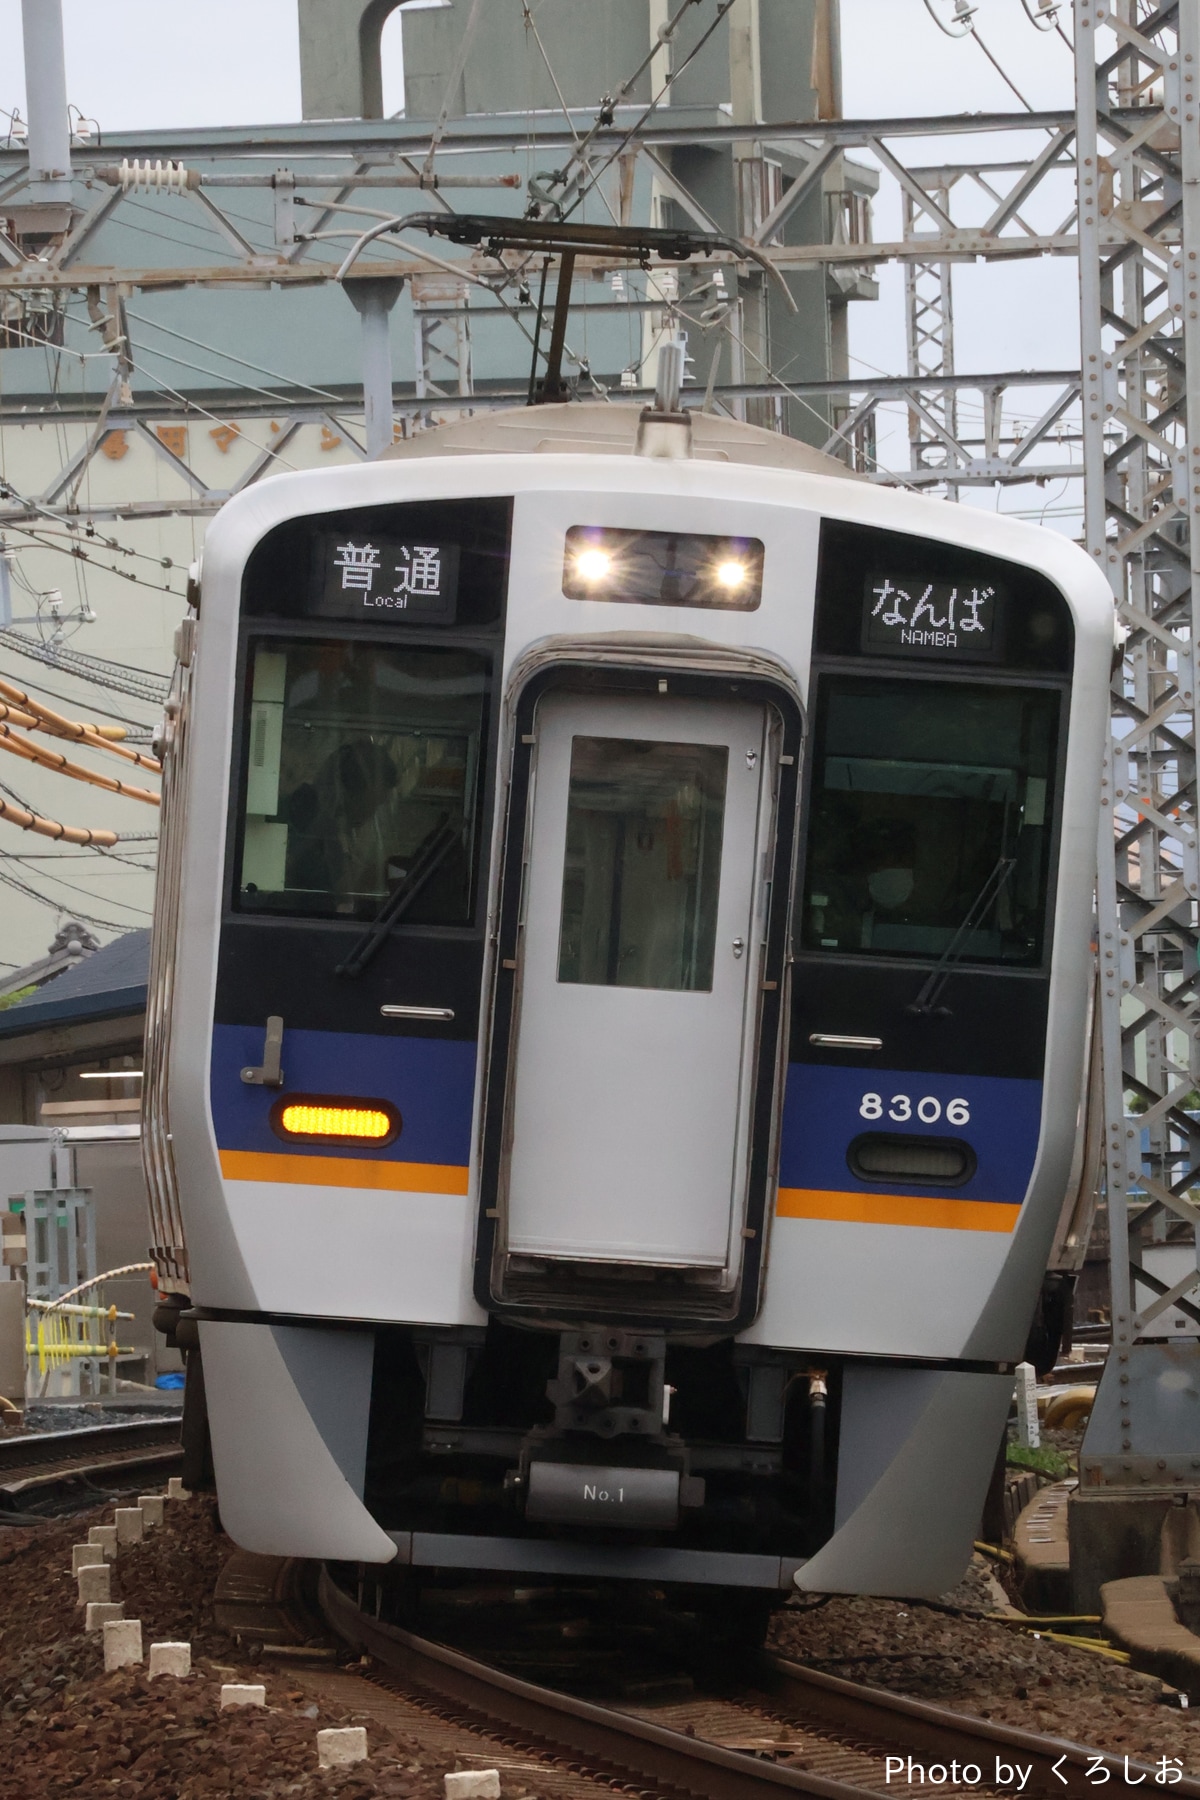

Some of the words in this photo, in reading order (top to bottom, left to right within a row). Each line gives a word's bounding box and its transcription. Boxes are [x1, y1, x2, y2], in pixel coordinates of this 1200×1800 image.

[333, 541, 441, 596] 普通
[363, 591, 408, 609] Local
[871, 579, 996, 632] なんば
[901, 629, 958, 648] NAMBA
[859, 1092, 970, 1126] 8306
[583, 1484, 624, 1503] No.1
